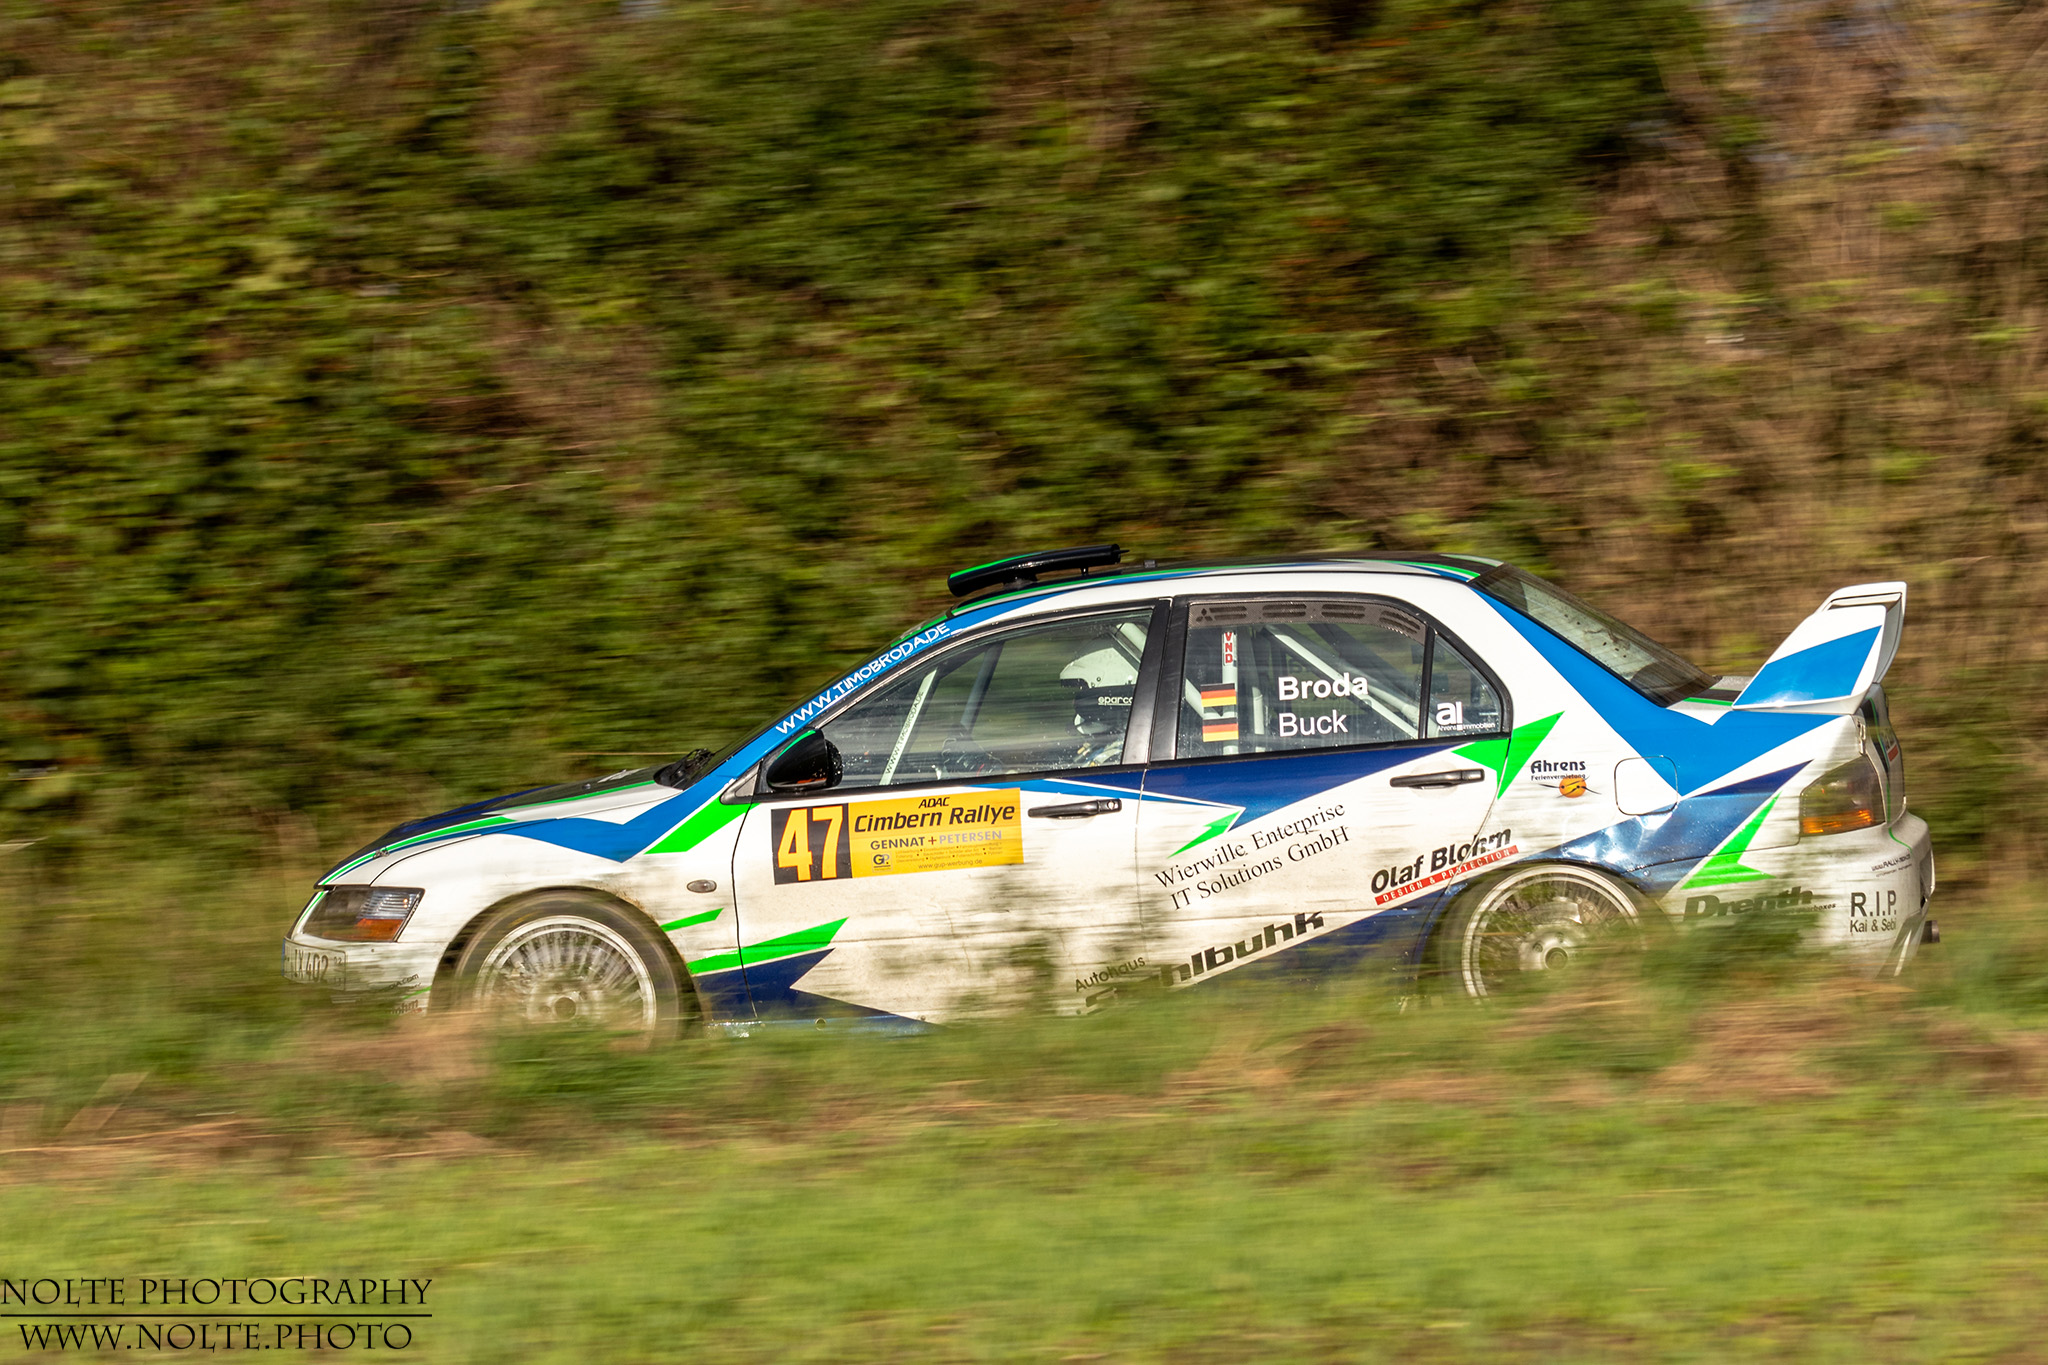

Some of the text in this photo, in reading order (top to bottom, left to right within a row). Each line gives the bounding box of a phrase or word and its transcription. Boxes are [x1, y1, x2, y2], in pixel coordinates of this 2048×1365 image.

[776, 623, 951, 734] WWW.TIMOBRODA.DE
[1278, 672, 1369, 701] Broda
[1278, 709, 1349, 737] Buck
[1530, 759, 1586, 774] Ahrens
[854, 805, 1015, 833] Cimbern Rallye
[918, 797, 950, 809] ADAC
[777, 804, 844, 882] 47
[870, 836, 926, 851] GENNAT
[939, 830, 1002, 845] PETERSEN
[1154, 804, 1346, 889] Wierwille Enterprise
[1170, 825, 1351, 912] IT Solutions GmbH
[1371, 828, 1512, 894] Olaf Blohm
[1383, 881, 1423, 902] DESIGN
[1441, 849, 1511, 880] PROTECTION
[1850, 918, 1897, 933] Kai & Sebi
[1074, 957, 1146, 993] Autohaus
